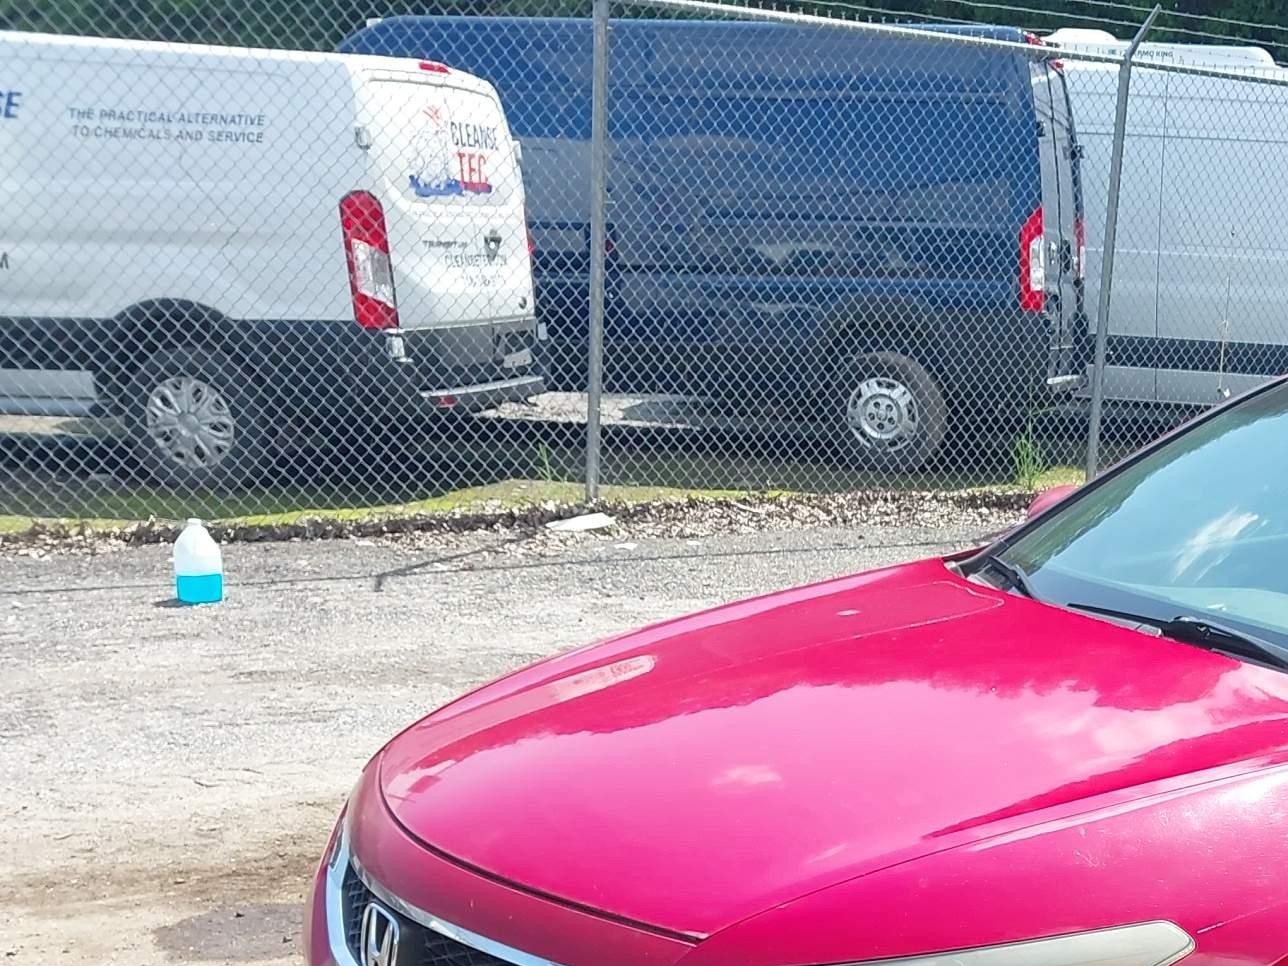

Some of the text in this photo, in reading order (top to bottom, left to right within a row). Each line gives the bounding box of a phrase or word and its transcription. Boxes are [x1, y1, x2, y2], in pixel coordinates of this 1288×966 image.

[0, 91, 22, 118] E
[69, 107, 266, 127] THE PRACTICAL ALTERNATIVE
[72, 124, 264, 144] TO CHEMICALS AND SERVICE
[450, 121, 499, 151] CLEANSE
[457, 152, 488, 186] TEC
